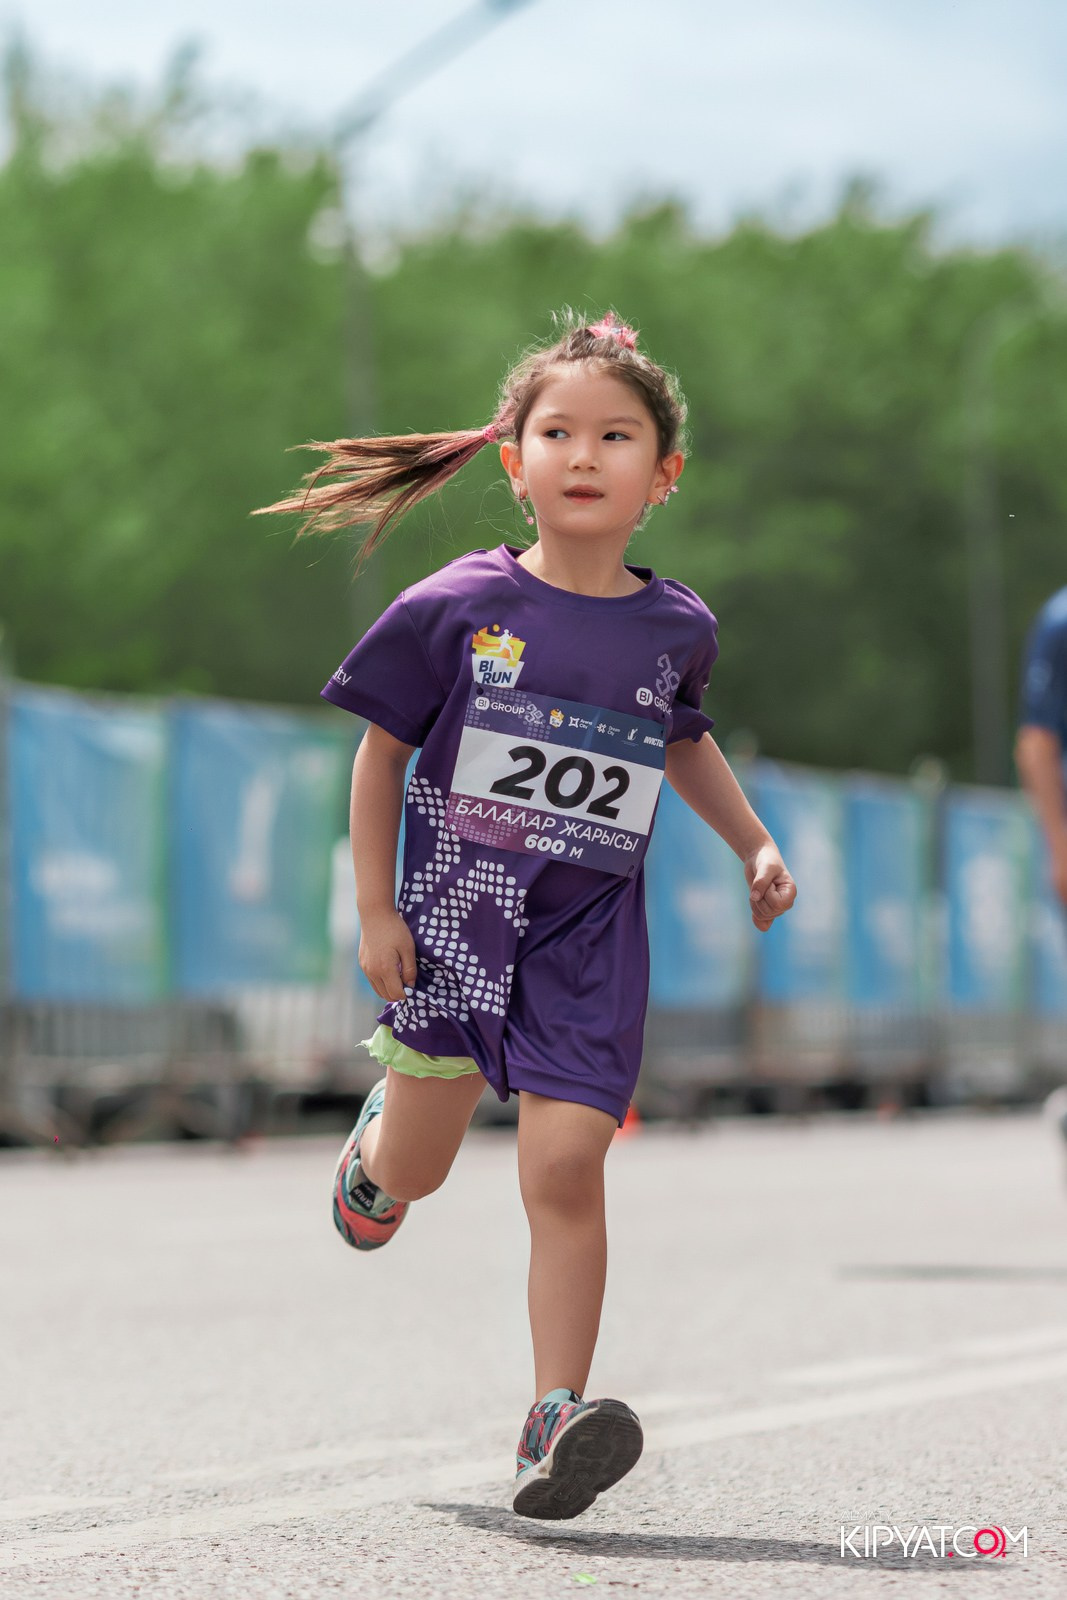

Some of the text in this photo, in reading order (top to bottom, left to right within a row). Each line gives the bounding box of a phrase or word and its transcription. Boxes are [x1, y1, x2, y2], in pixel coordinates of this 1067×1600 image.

[479, 660, 494, 673] BI
[482, 671, 513, 684] RUN
[490, 701, 526, 715] GROUP
[489, 745, 631, 821] 202
[455, 798, 640, 853] БАЛАЛАР ЖАРЫСЫ
[524, 833, 567, 855] 600
